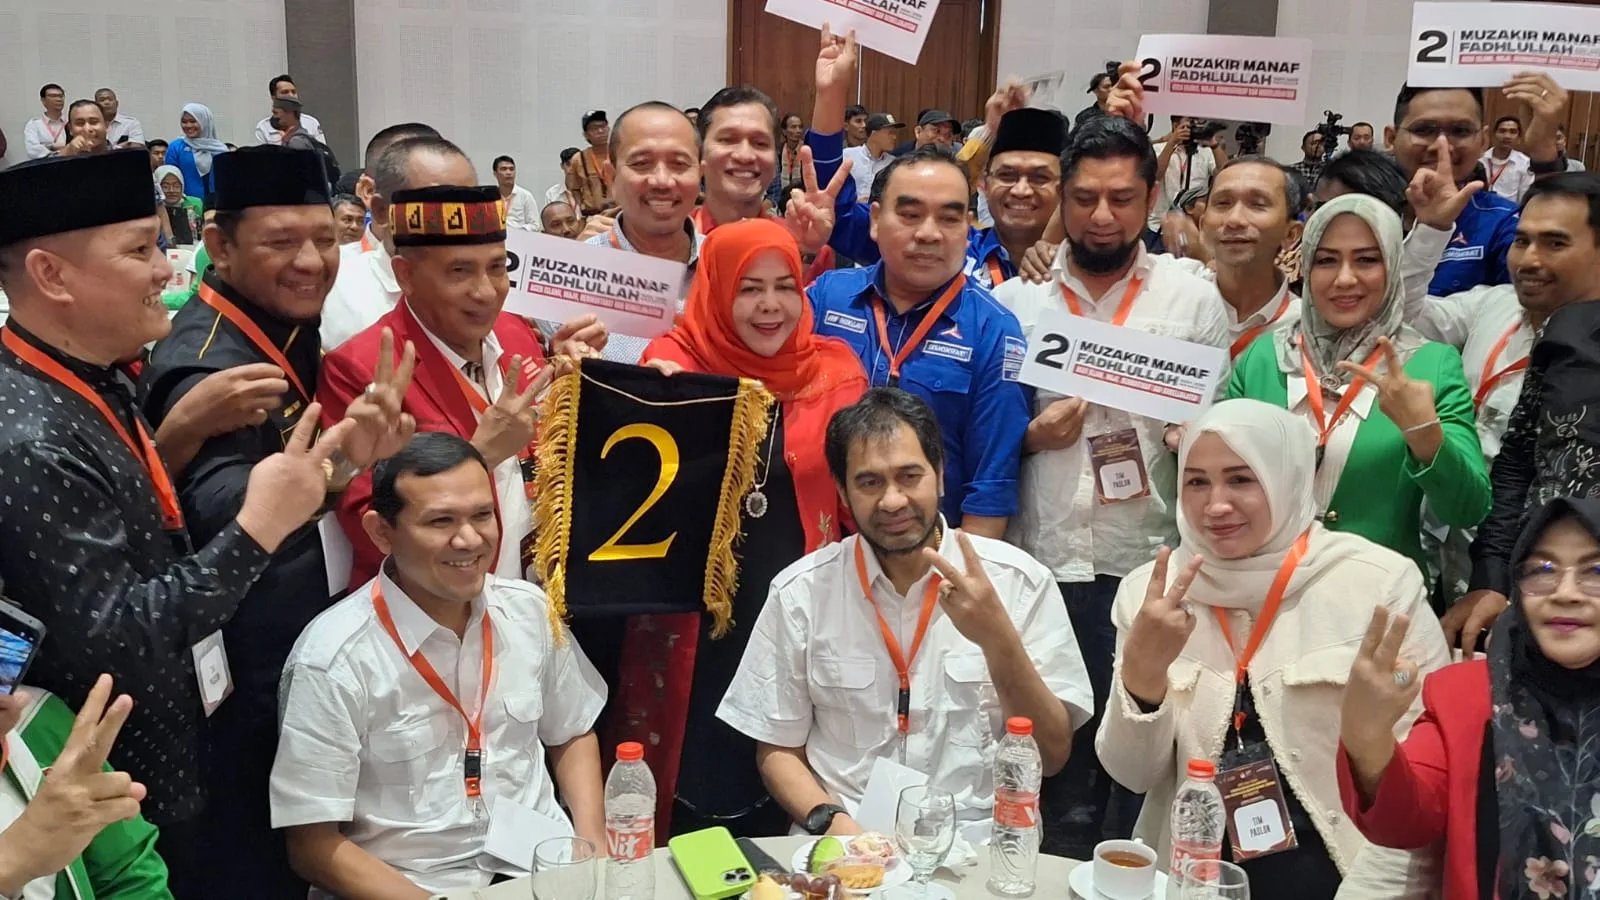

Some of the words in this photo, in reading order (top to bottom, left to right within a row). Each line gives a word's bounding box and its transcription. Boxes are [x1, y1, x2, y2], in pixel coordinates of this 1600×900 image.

[1416, 30, 1448, 63] 2
[1459, 42, 1573, 54] FADHLULLAH
[1460, 30, 1538, 41] MUZAKIR
[1542, 31, 1600, 45] MANAF
[1138, 57, 1162, 93] 2
[1170, 70, 1272, 85] FADHLULLAH
[1171, 57, 1240, 70] MUZAKIR
[1243, 61, 1300, 74] MANAF
[529, 269, 640, 301] FADHLULLAH
[532, 256, 608, 282] MUZAKIR
[611, 272, 671, 294] MANAF
[1035, 333, 1070, 370] 2
[1080, 341, 1149, 367] MUZAKIR
[1151, 359, 1210, 380] MANAF
[1076, 353, 1179, 386] FADHLULLAH
[588, 423, 680, 561] 2
